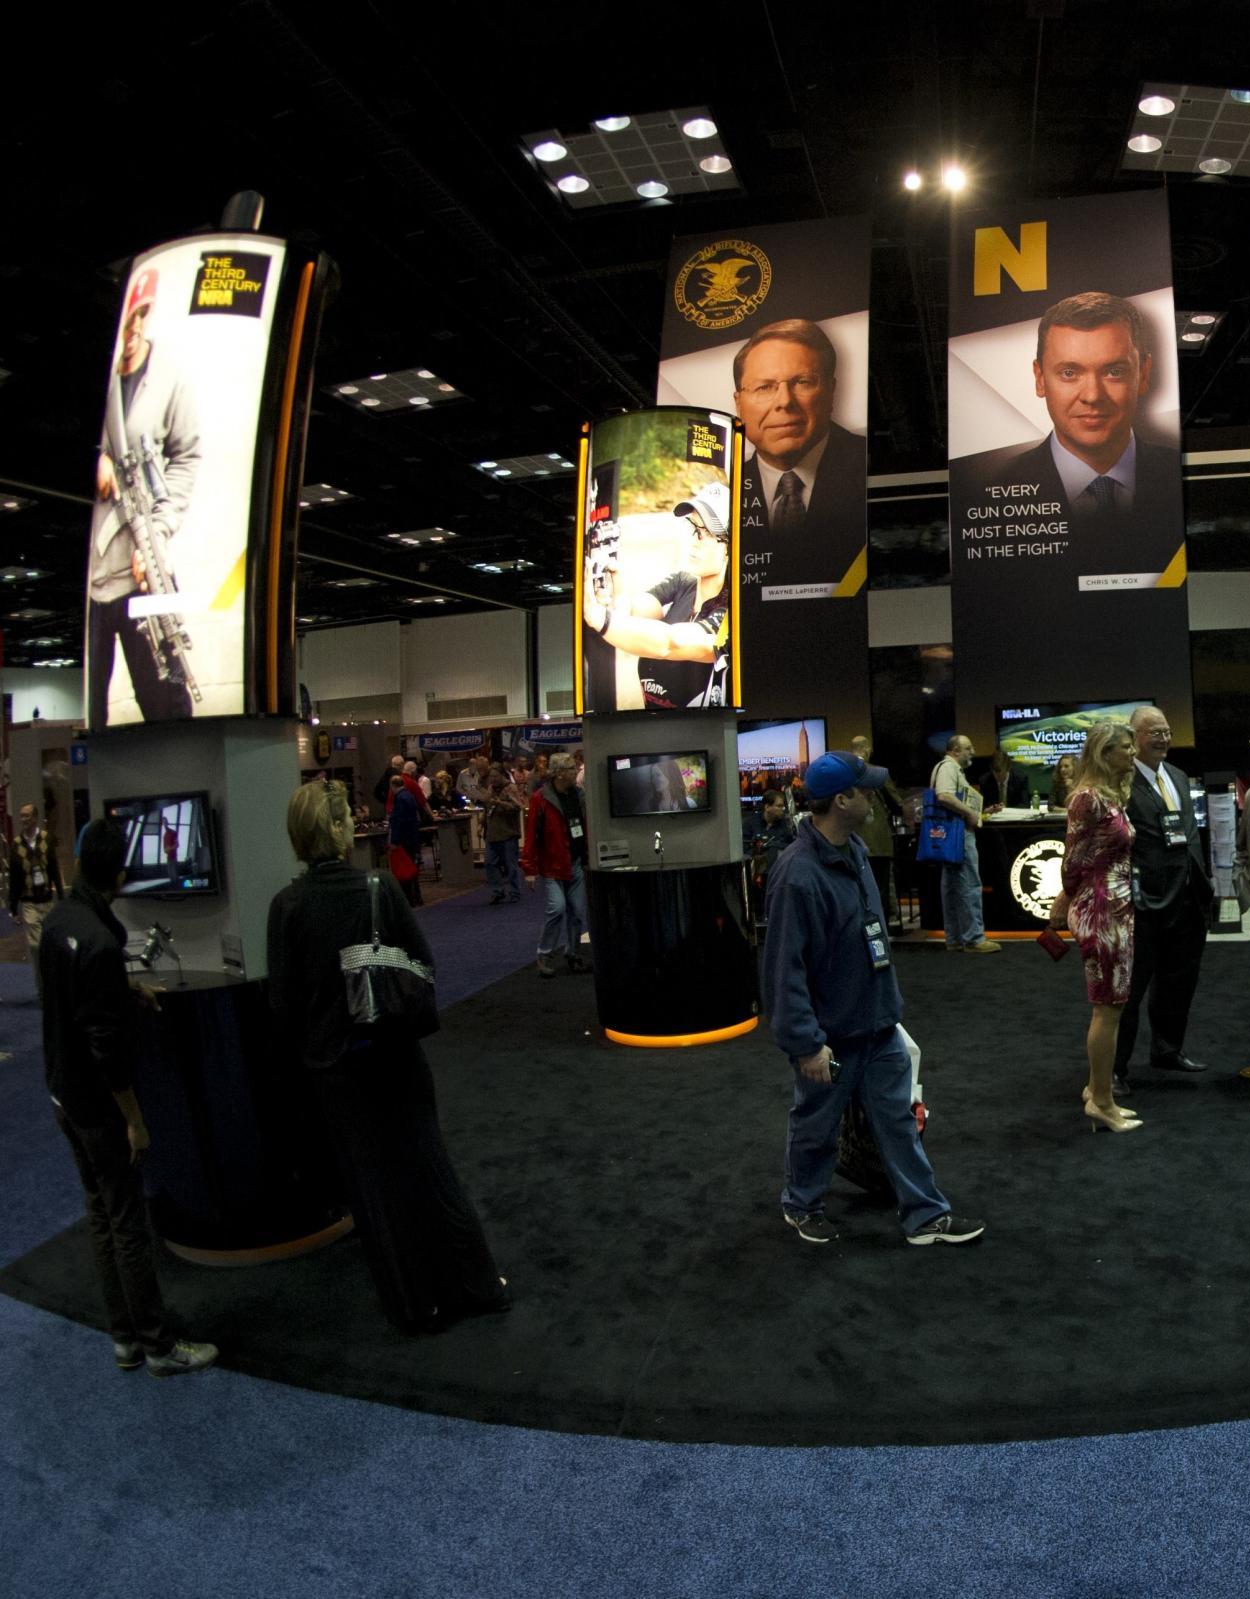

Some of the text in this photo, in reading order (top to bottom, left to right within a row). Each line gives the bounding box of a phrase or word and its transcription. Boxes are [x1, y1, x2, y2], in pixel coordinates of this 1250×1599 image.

[207, 257, 232, 267] THE
[974, 221, 1047, 296] N
[204, 268, 246, 279] THIRD
[201, 279, 261, 292] CENTURY
[198, 290, 233, 306] NRA
[710, 314, 740, 327] AMERICA
[693, 424, 708, 433] THE
[693, 432, 717, 442] THIRD
[693, 439, 724, 451] CENTURY
[985, 484, 1041, 498] "EVERY
[967, 503, 1061, 520] GUN OWNER
[962, 522, 1068, 540] MUST ENGAGE
[967, 542, 1069, 559] IN THE FIGHT."
[640, 679, 667, 695] Team
[1033, 730, 1087, 743] Victories
